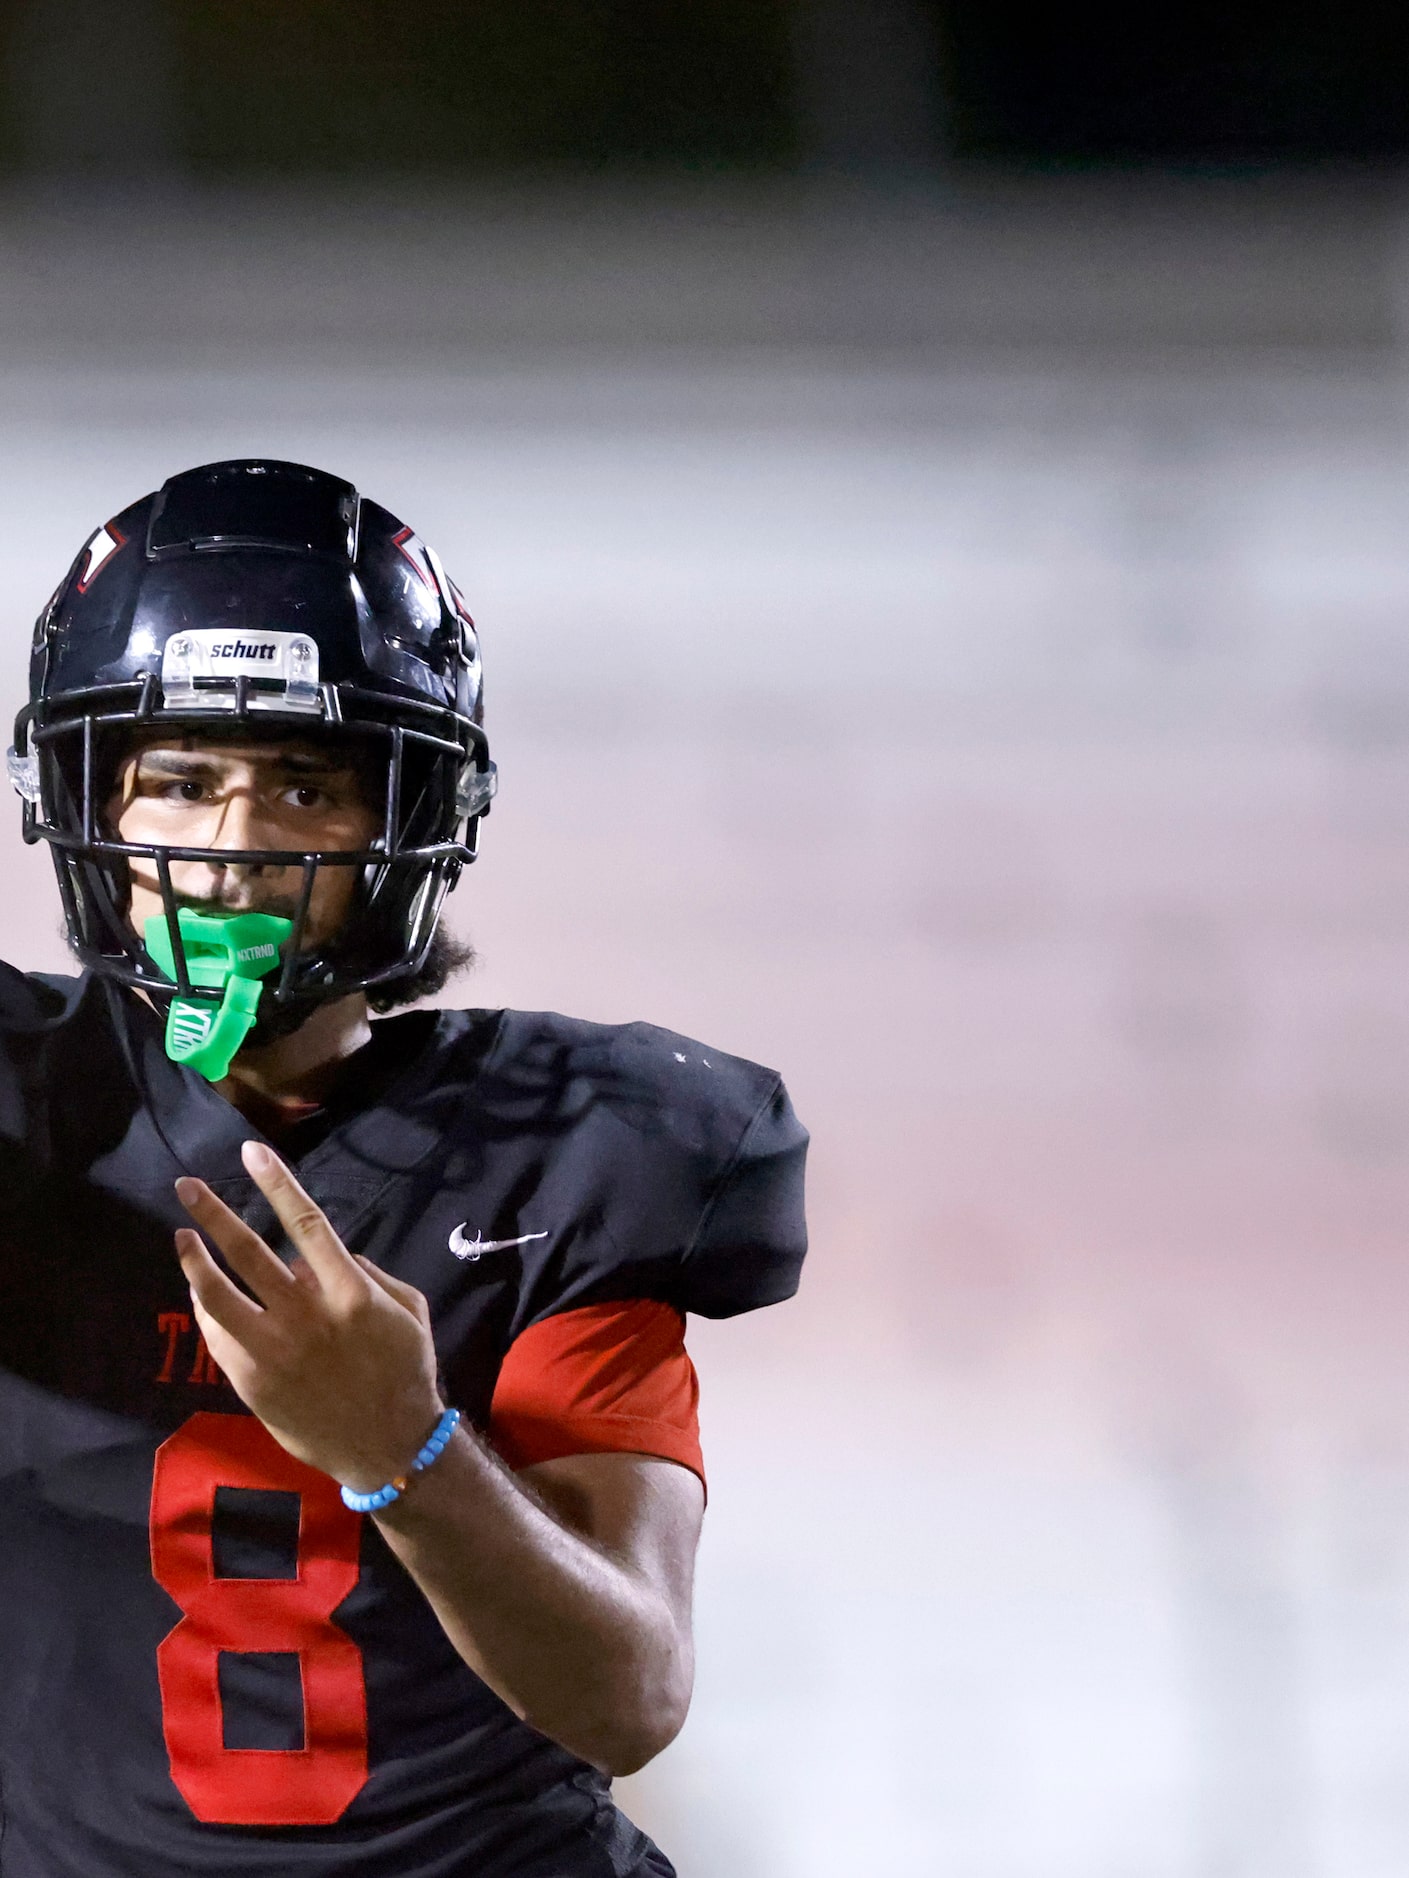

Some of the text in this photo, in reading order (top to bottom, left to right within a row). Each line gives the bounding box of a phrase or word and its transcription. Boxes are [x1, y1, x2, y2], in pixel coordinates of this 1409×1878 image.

[210, 640, 276, 660] schutt
[236, 943, 274, 962] NXTRND
[149, 1411, 370, 1825] 8
